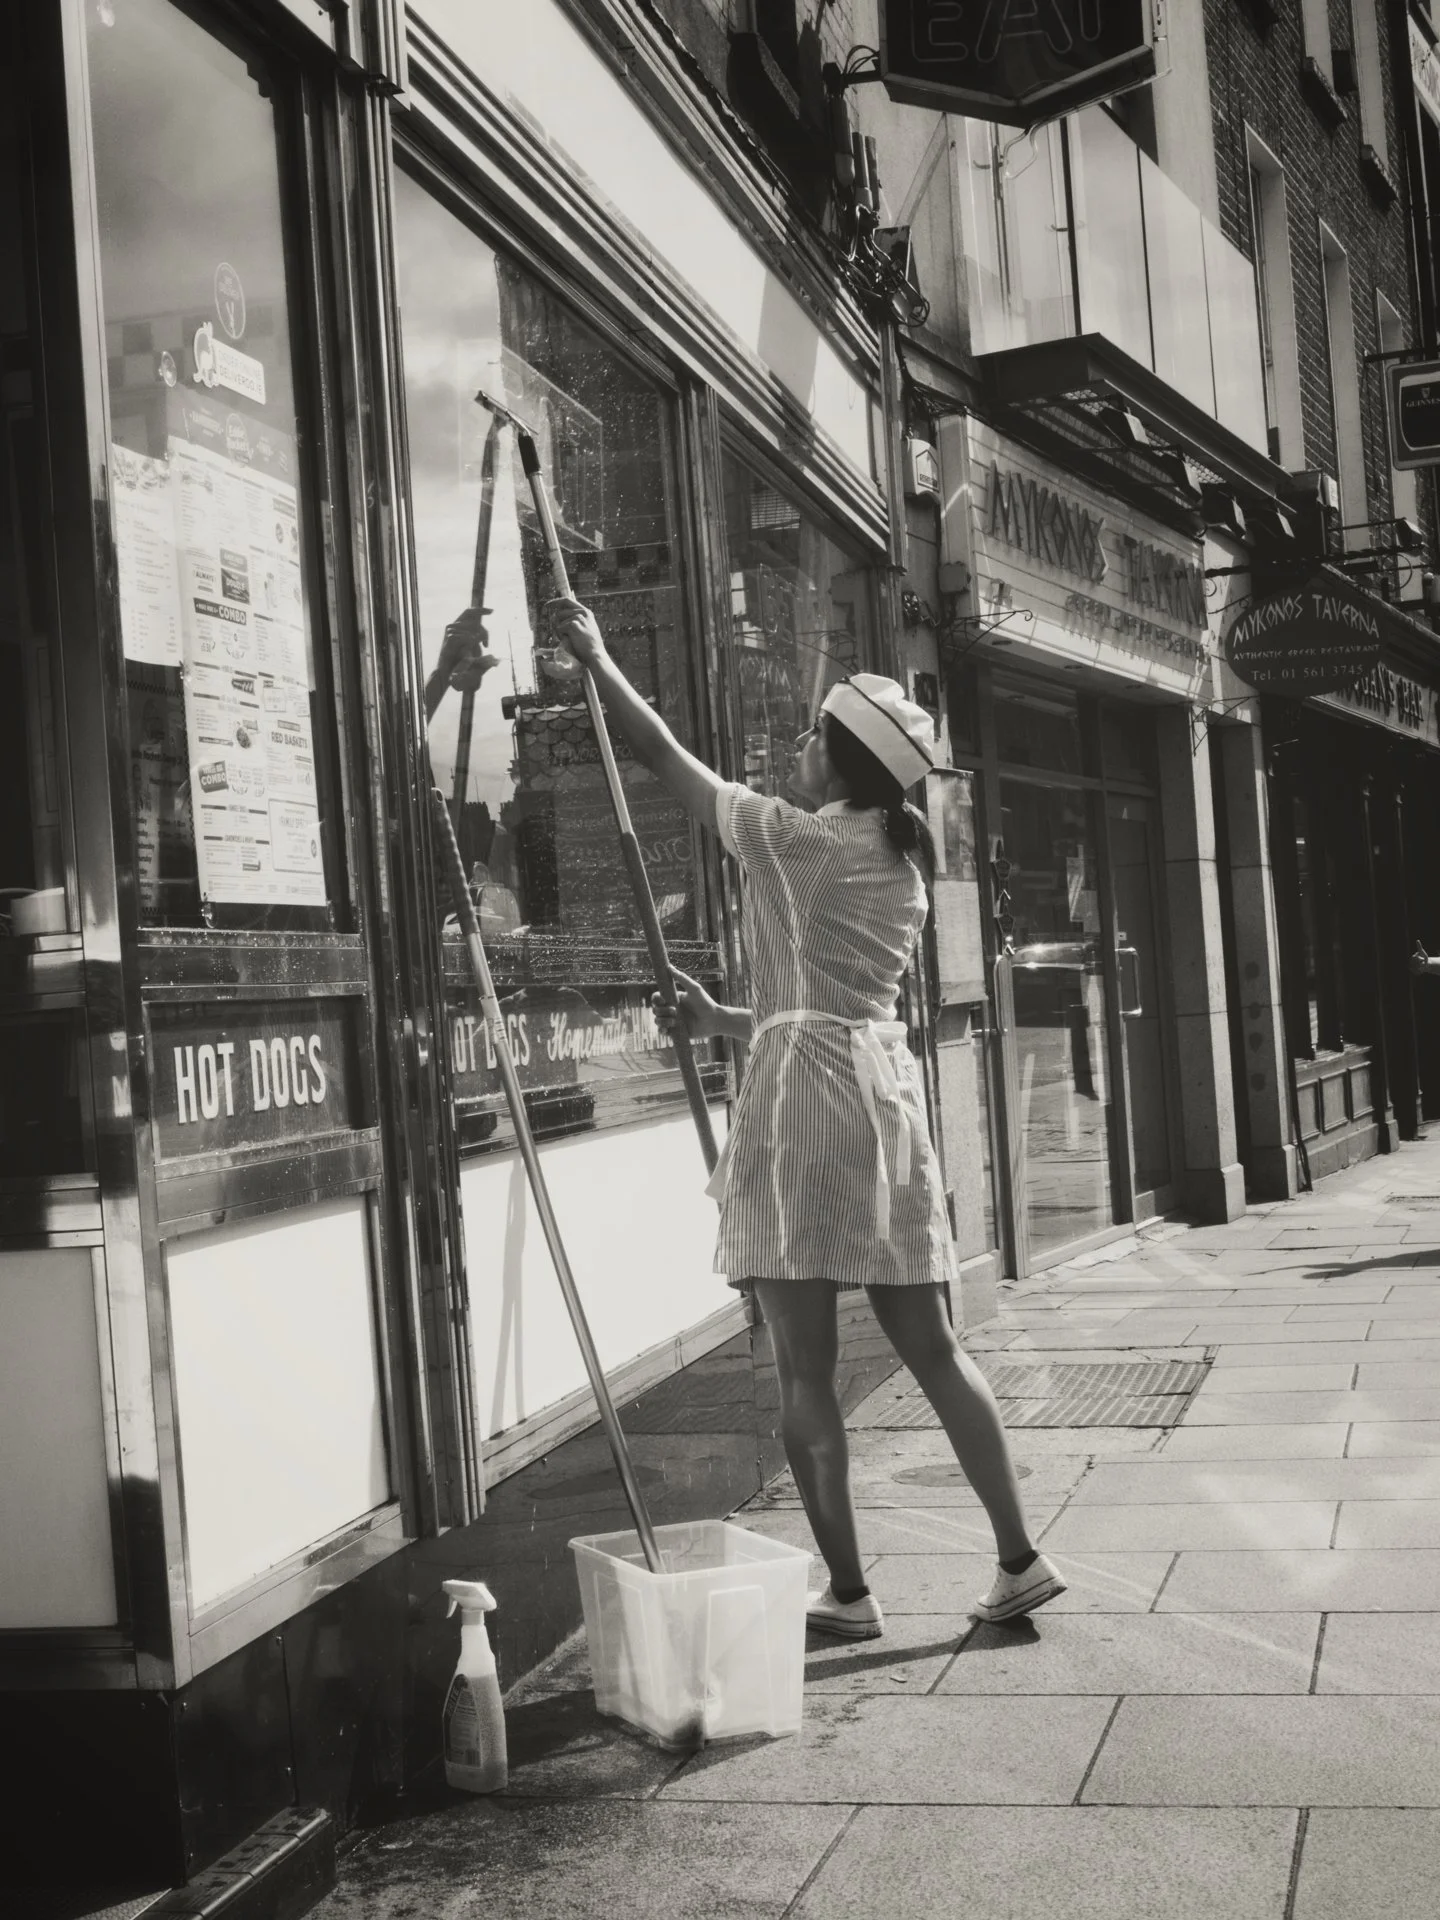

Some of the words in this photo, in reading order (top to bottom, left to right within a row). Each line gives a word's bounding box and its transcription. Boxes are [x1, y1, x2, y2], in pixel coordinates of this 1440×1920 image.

[218, 605, 247, 624] COMBO
[1233, 593, 1304, 648] MYKONOS
[1311, 594, 1380, 639] TAVERNA
[1281, 668, 1296, 680] 01
[449, 1016, 477, 1074] OT
[484, 1013, 531, 1070] DGS
[547, 1008, 627, 1062] Homemade
[174, 1042, 235, 1124] HOT
[249, 1034, 327, 1112] DOGS
